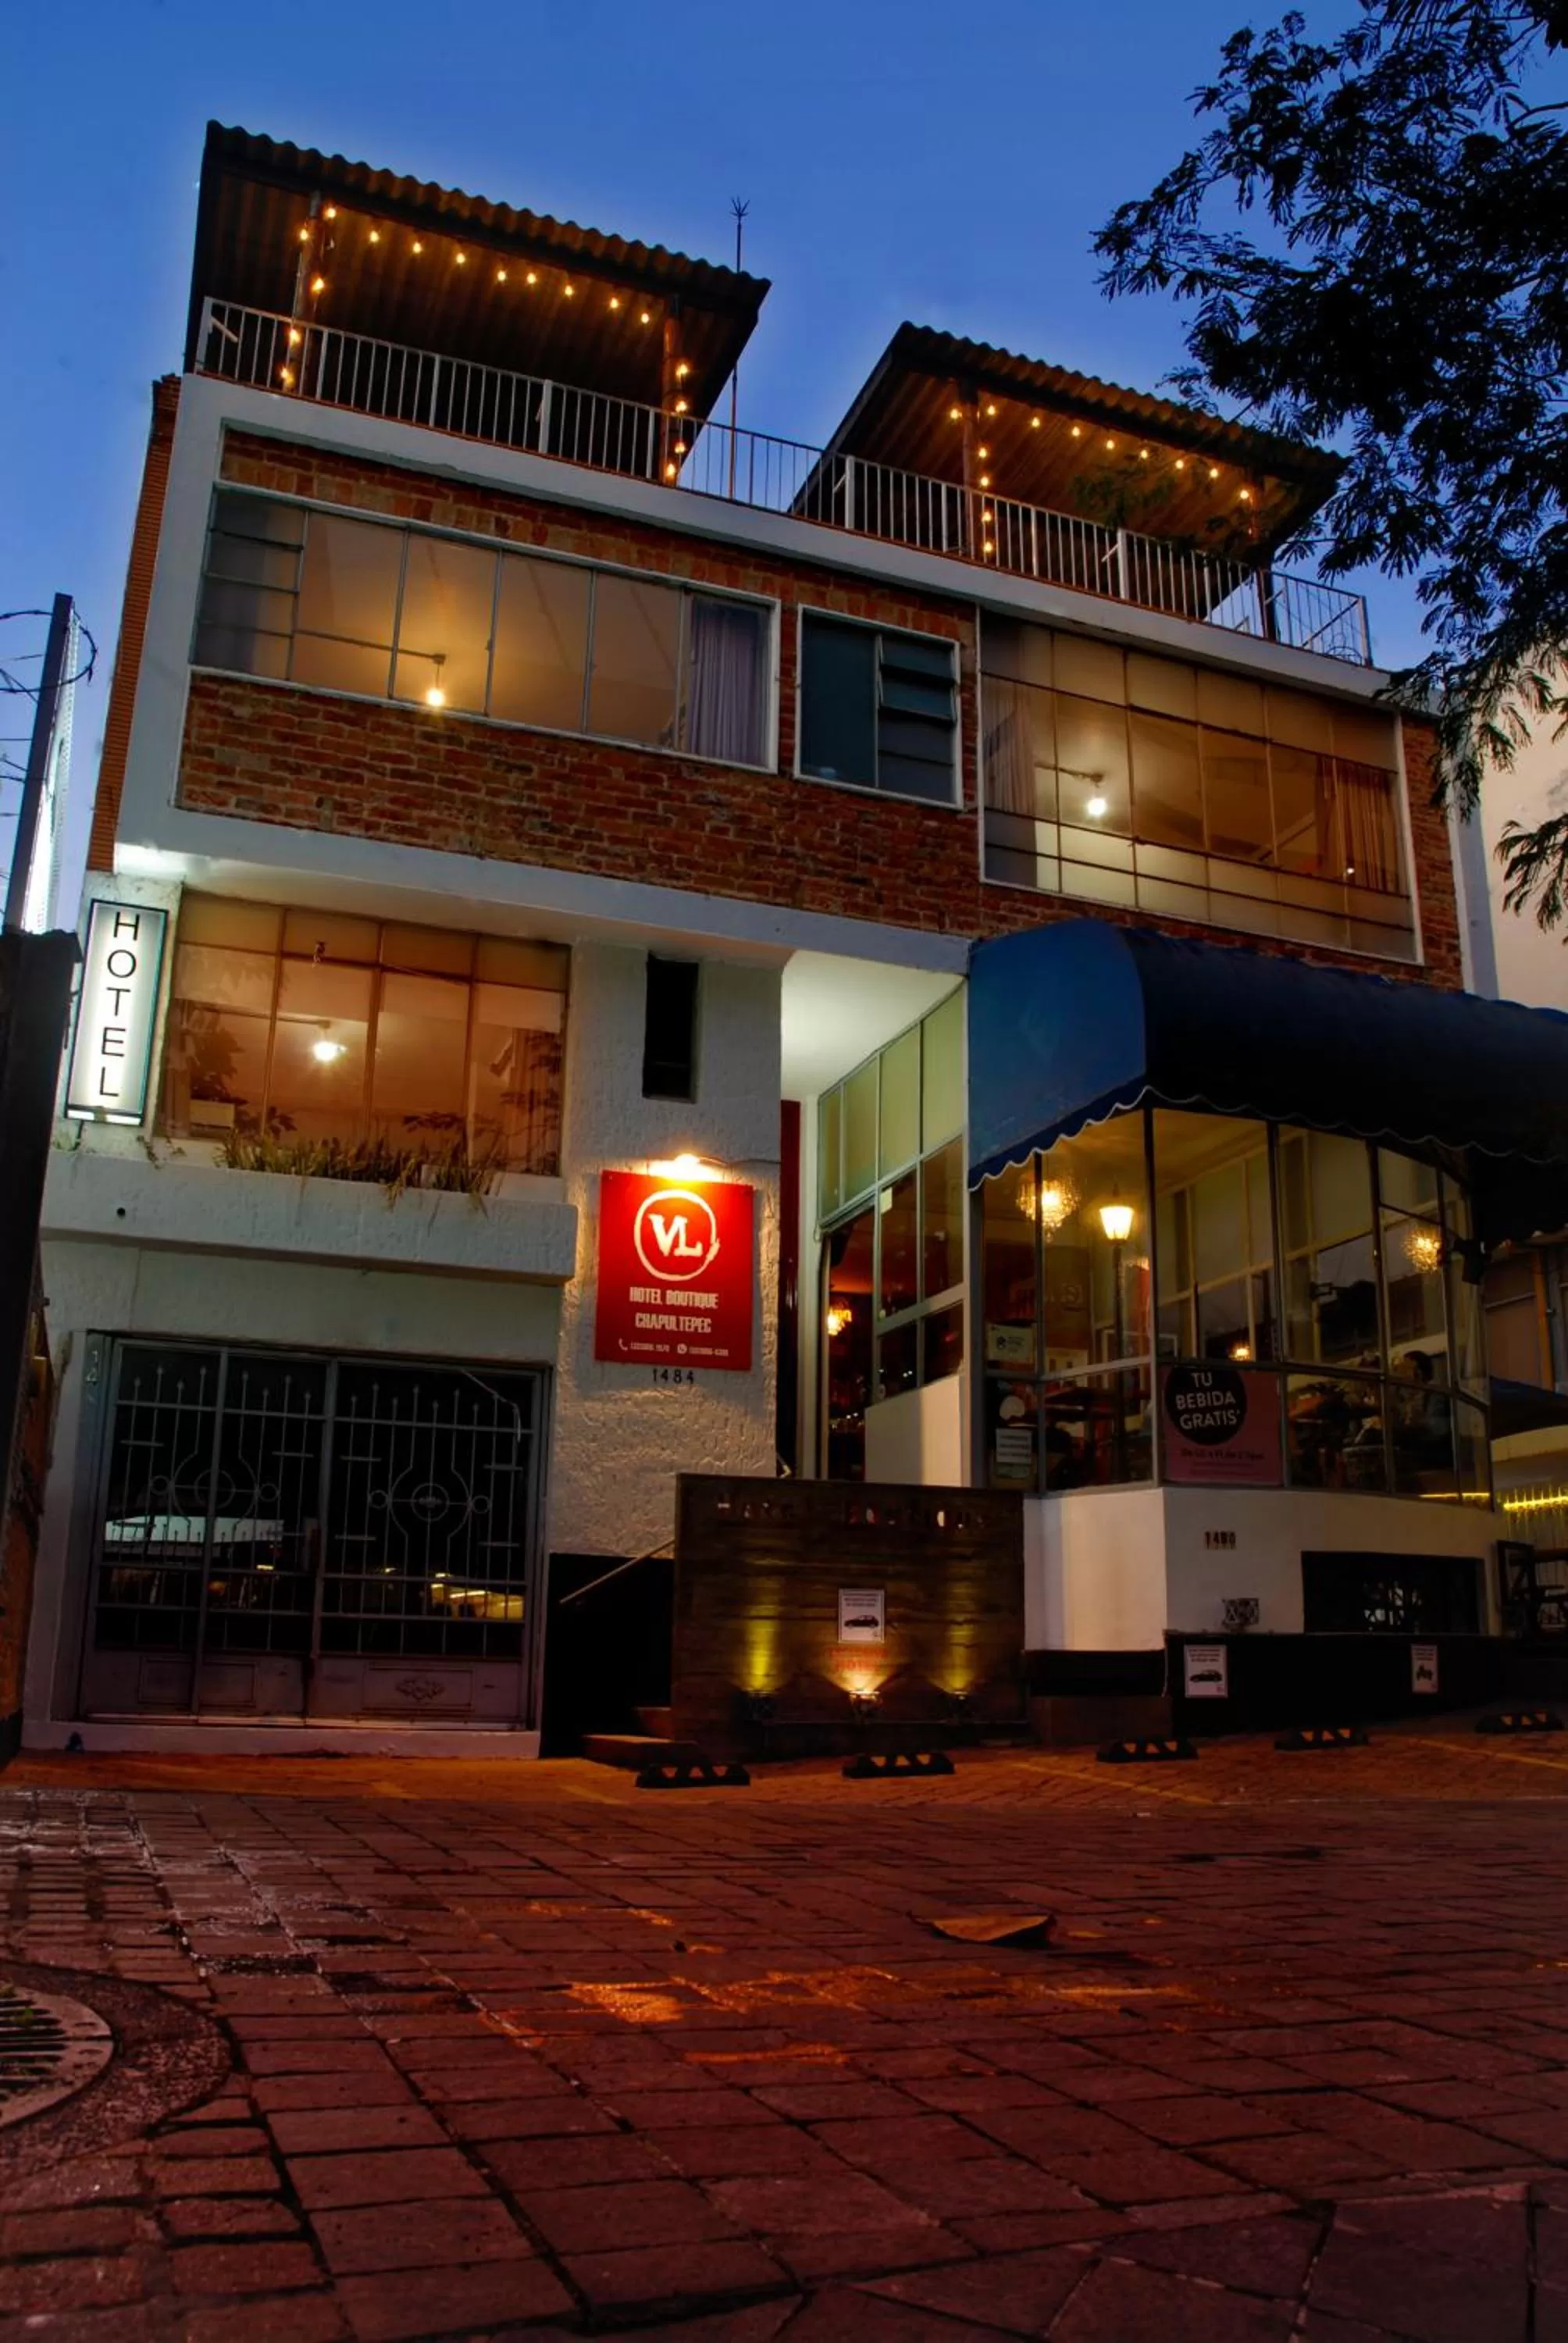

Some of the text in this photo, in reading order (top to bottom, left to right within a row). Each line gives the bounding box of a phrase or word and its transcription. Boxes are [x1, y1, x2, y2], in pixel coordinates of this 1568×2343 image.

[100, 911, 140, 1097] HOTEL
[648, 1214, 703, 1257] VL
[629, 1286, 719, 1309] HOTEL BOUTIQUE
[635, 1312, 711, 1333] CHAPULTEPEC
[652, 1368, 694, 1385] 1484
[1190, 1371, 1213, 1388] TU
[1175, 1390, 1236, 1410] BEBIDA
